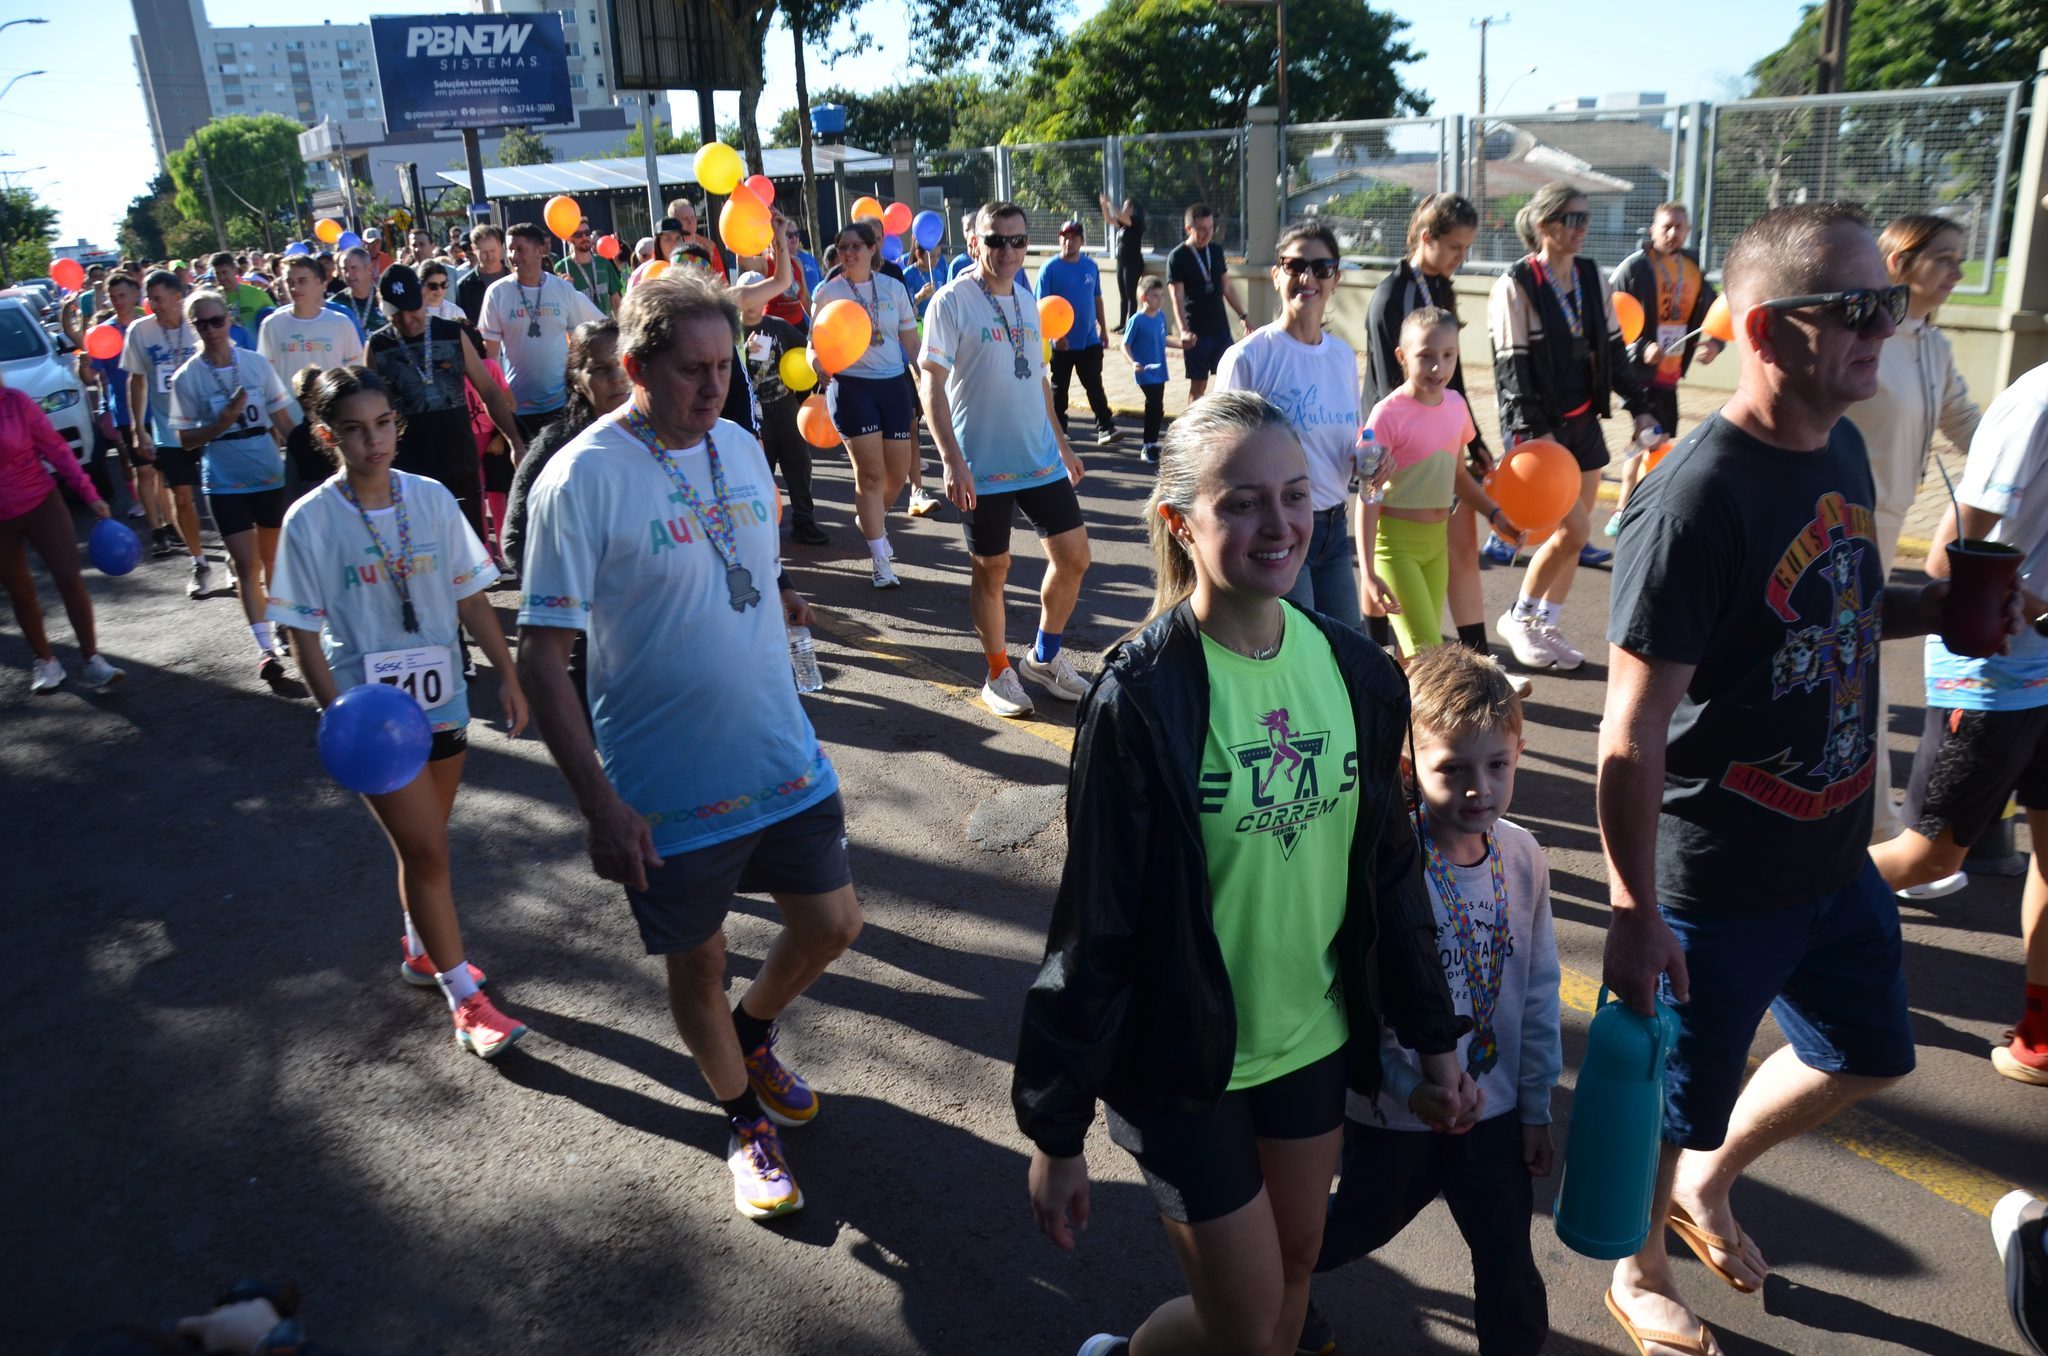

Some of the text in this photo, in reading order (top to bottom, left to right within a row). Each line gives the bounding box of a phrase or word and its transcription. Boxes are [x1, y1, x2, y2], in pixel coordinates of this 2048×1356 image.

[406, 23, 533, 58] PBNEW
[440, 56, 538, 71] SISTEMAS
[433, 77, 519, 90] Soluções tecnológicas
[434, 89, 447, 97] em
[448, 87, 482, 97] produtos
[862, 424, 879, 433] RUN
[1235, 798, 1339, 833] CORREM
[1478, 900, 1494, 912] ALL
